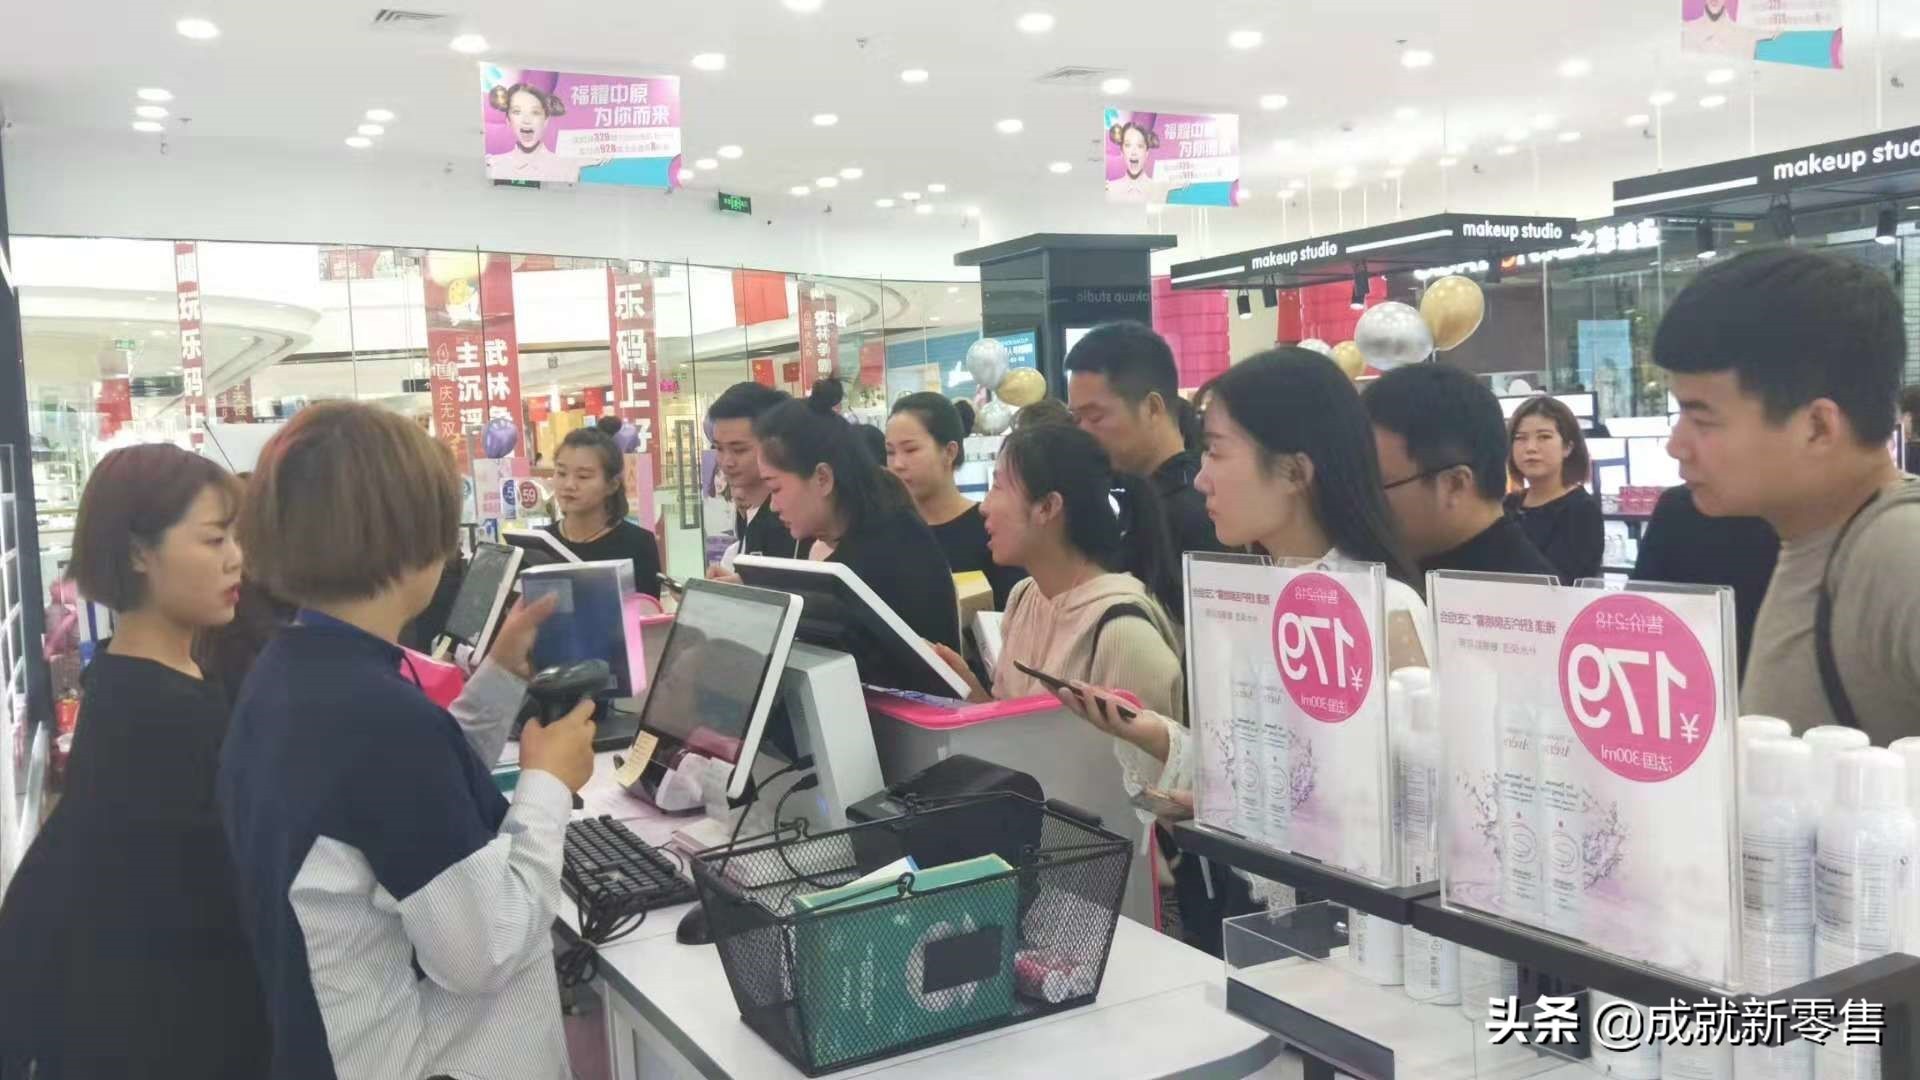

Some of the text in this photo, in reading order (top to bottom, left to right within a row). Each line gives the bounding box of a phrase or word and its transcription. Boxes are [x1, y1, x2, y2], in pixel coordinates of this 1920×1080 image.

[570, 84, 648, 105] 福耀中原
[594, 104, 670, 127] 为你而来
[1773, 149, 1866, 181] makeup
[1463, 221, 1519, 242] makeup
[1521, 222, 1563, 240] studio
[1252, 241, 1338, 270] makeup studio
